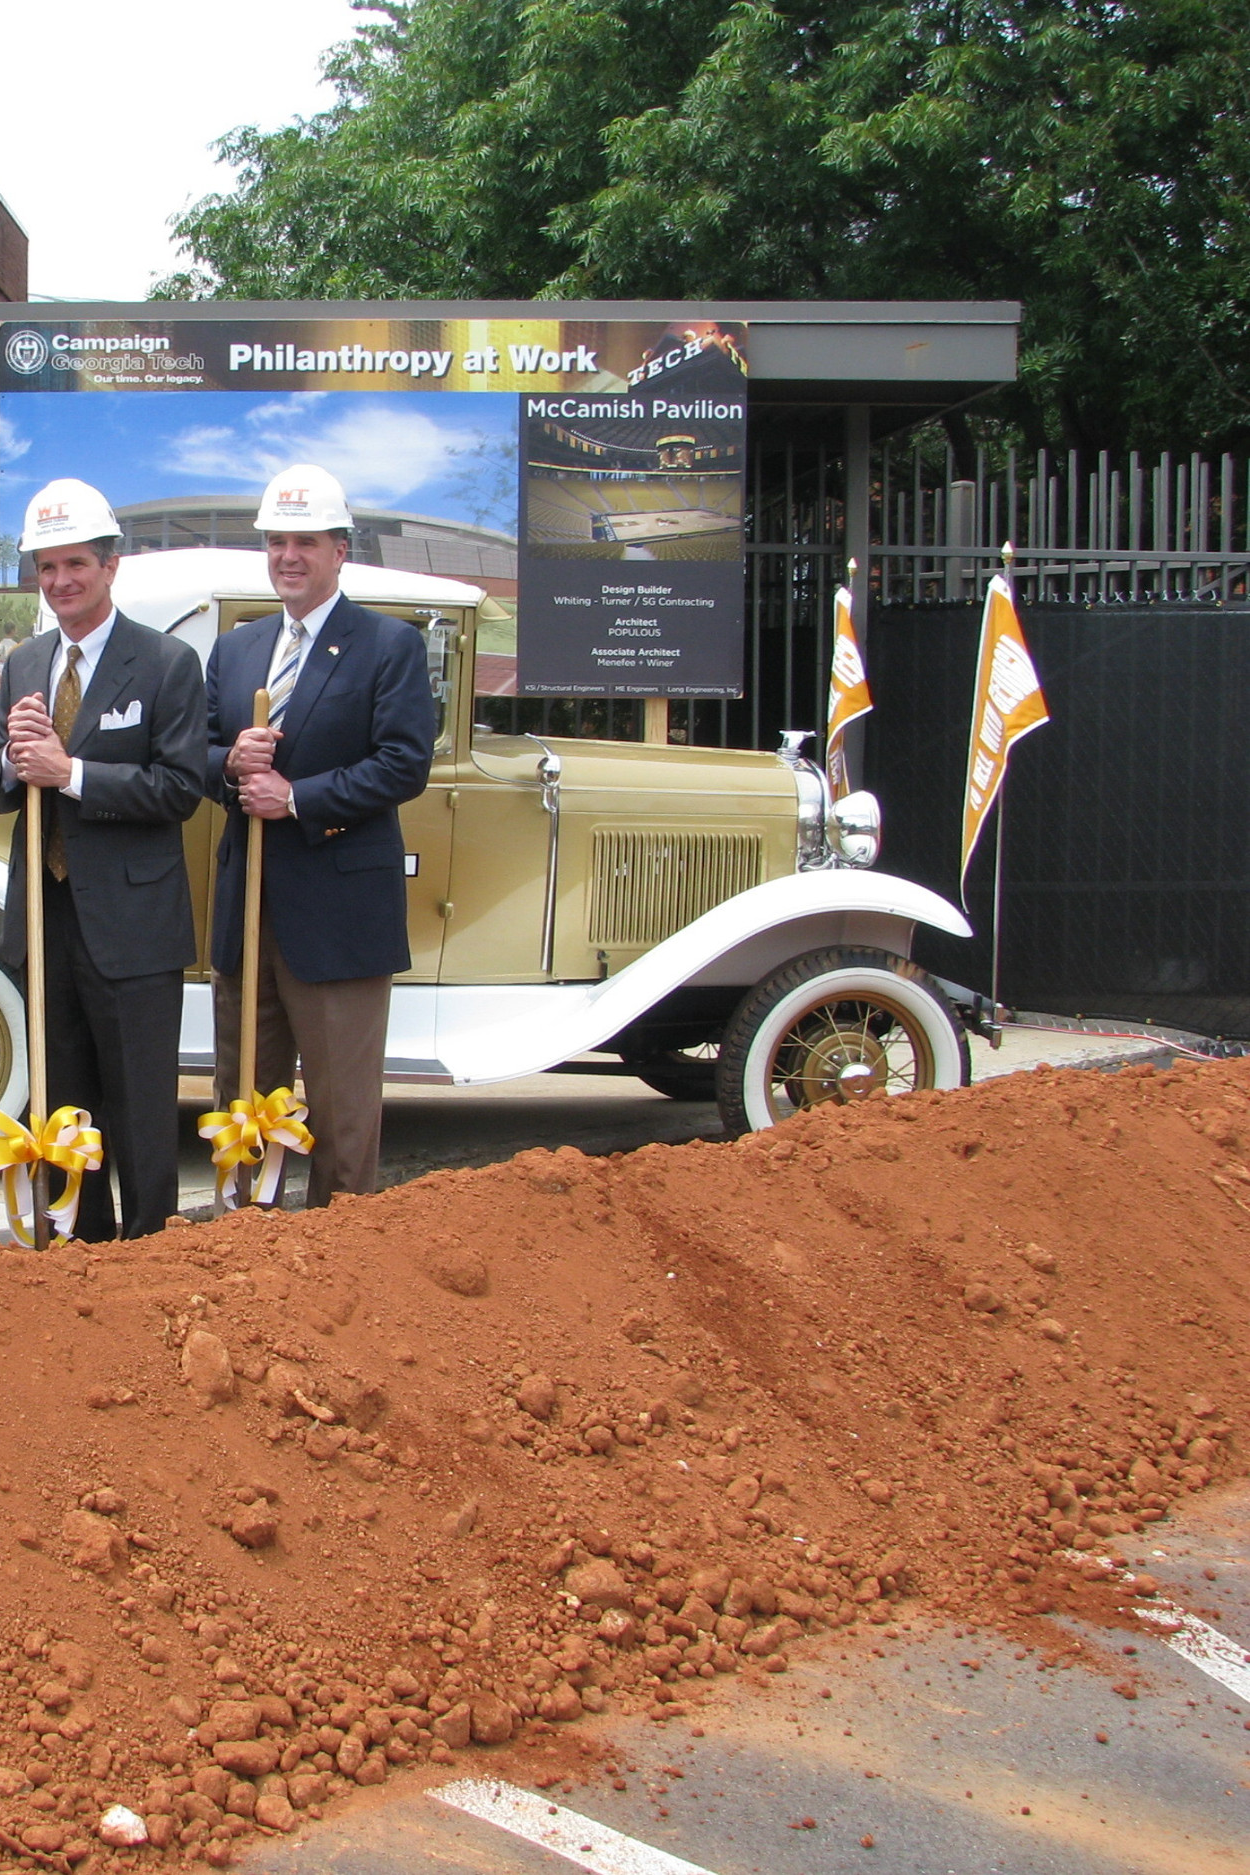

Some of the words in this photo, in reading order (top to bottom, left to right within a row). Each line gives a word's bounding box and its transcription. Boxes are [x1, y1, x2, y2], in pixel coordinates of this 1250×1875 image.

[51, 333, 170, 354] Campaign
[51, 353, 145, 373] Georgia
[147, 352, 204, 371] Tech
[228, 343, 452, 377] Philanthropy
[462, 345, 498, 373] at
[510, 345, 599, 373] Work
[626, 337, 704, 386] TECH
[94, 375, 113, 383] Our
[116, 374, 143, 383] time.
[144, 374, 164, 383] Our
[166, 374, 204, 385] legacy.
[527, 399, 645, 419] McCamish
[651, 399, 743, 420] Pavilion
[278, 488, 310, 501] WT
[37, 502, 69, 518] WT
[601, 585, 635, 596] Design
[637, 585, 672, 595] Builder
[554, 596, 591, 607] Whiting
[601, 597, 631, 606] Turner
[642, 597, 656, 607] SG
[658, 597, 714, 608] Contracting
[614, 617, 657, 627] Architect
[608, 628, 662, 637] POPULOUS
[591, 647, 635, 657] Associate
[638, 648, 681, 658] Architect
[646, 659, 674, 668] Winer
